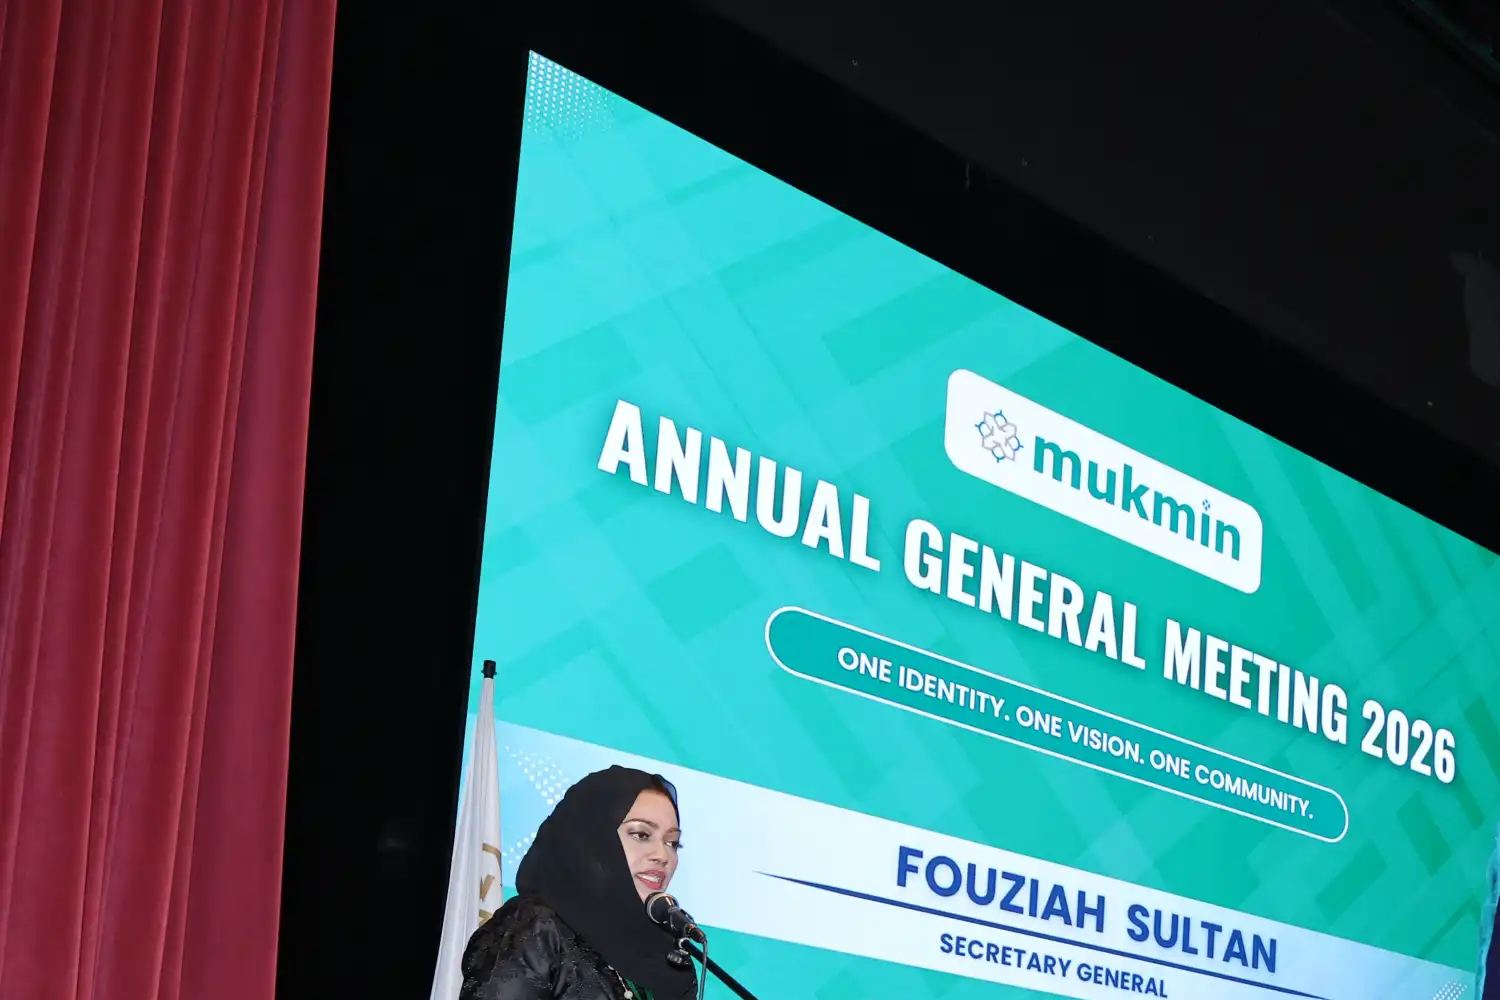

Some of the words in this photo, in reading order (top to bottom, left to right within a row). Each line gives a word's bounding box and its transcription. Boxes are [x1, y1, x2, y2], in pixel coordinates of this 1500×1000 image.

[1033, 430, 1241, 563] mukmin
[598, 399, 881, 573] ANNUAL
[903, 517, 1146, 671] GENERAL
[1164, 618, 1348, 746] MEETING
[1361, 698, 1457, 785] 2026
[837, 645, 892, 684] ONE
[898, 665, 1011, 722] IDENTITY.
[1015, 704, 1062, 740] ONE
[1067, 720, 1144, 766] VISION.
[1149, 748, 1191, 780] ONE
[1194, 763, 1314, 821] COMMUNITY.
[896, 845, 1106, 934] FOUZIAH
[1126, 903, 1278, 975] SULTAN
[939, 931, 1072, 980] SECRETARY
[1076, 962, 1168, 1000] GENERAL
